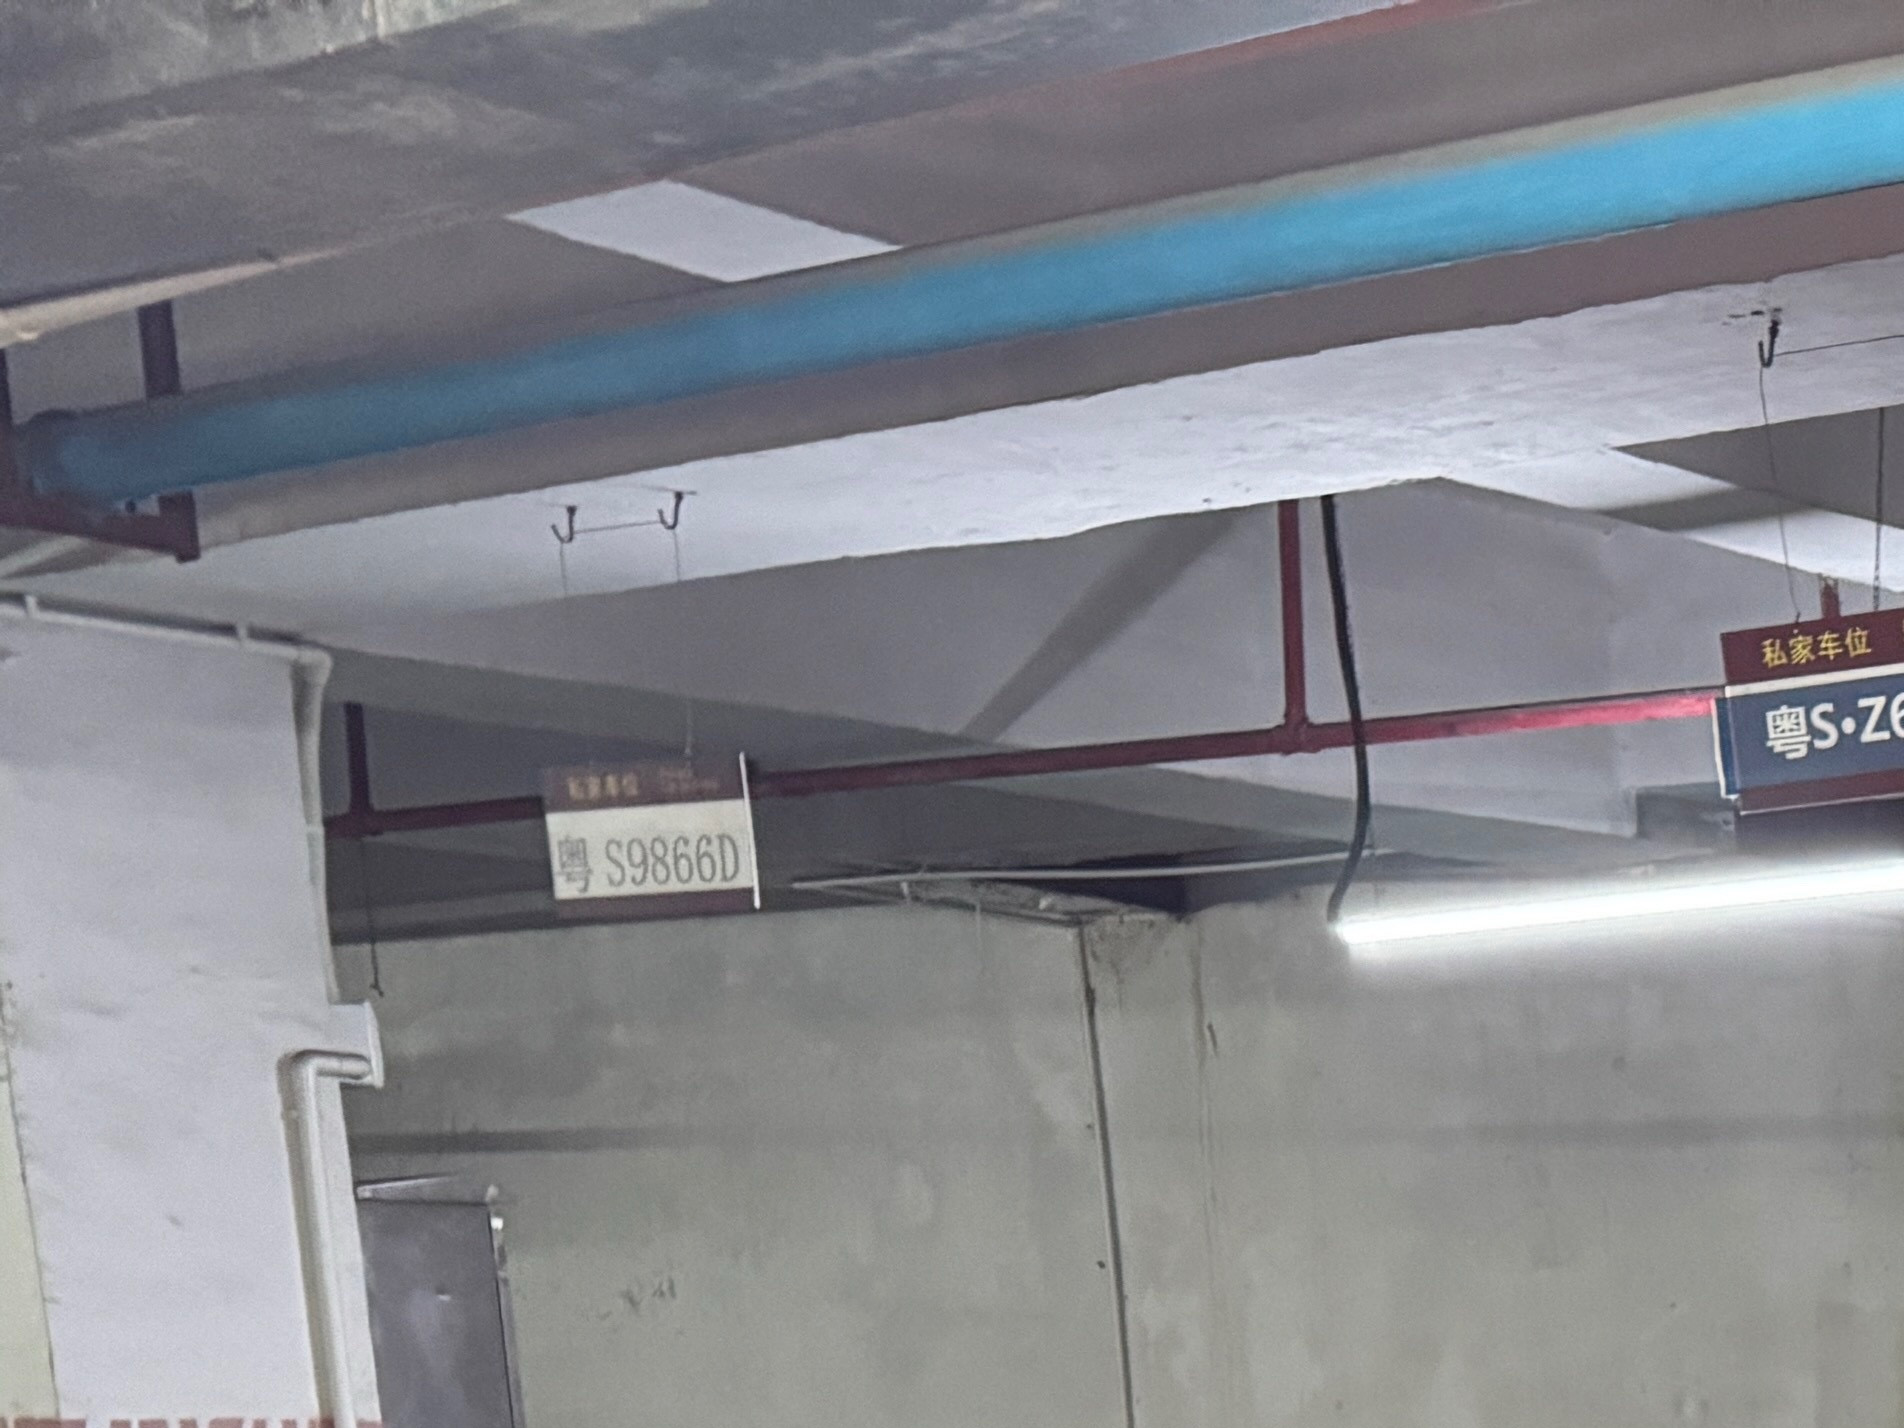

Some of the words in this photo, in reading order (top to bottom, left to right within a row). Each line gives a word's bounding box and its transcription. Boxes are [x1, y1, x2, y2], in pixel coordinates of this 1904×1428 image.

[1762, 626, 1872, 669] 私家车位
[604, 832, 740, 888] S9866D
